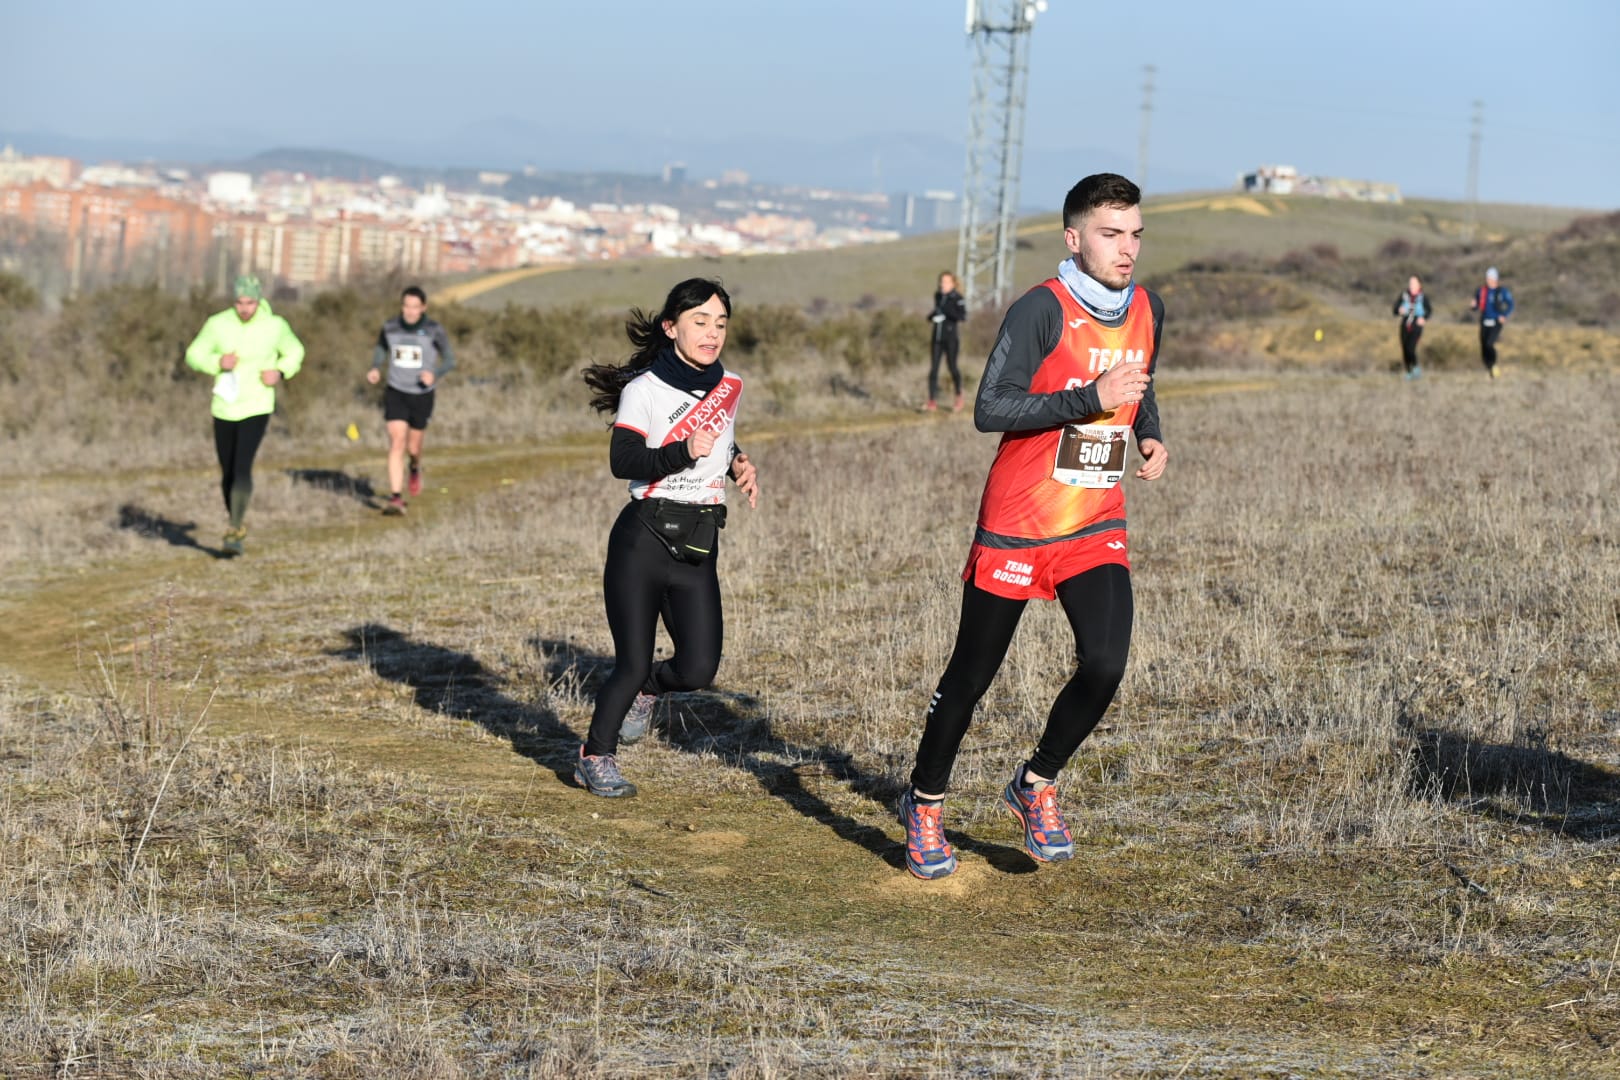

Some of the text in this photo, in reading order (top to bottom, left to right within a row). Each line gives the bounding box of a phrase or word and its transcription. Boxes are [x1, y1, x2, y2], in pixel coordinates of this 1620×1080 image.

[1088, 347, 1144, 374] TEAM
[671, 382, 734, 442] LA DESPENSA
[699, 408, 733, 434] ER
[1079, 442, 1111, 465] 508
[1005, 560, 1033, 575] TEAM
